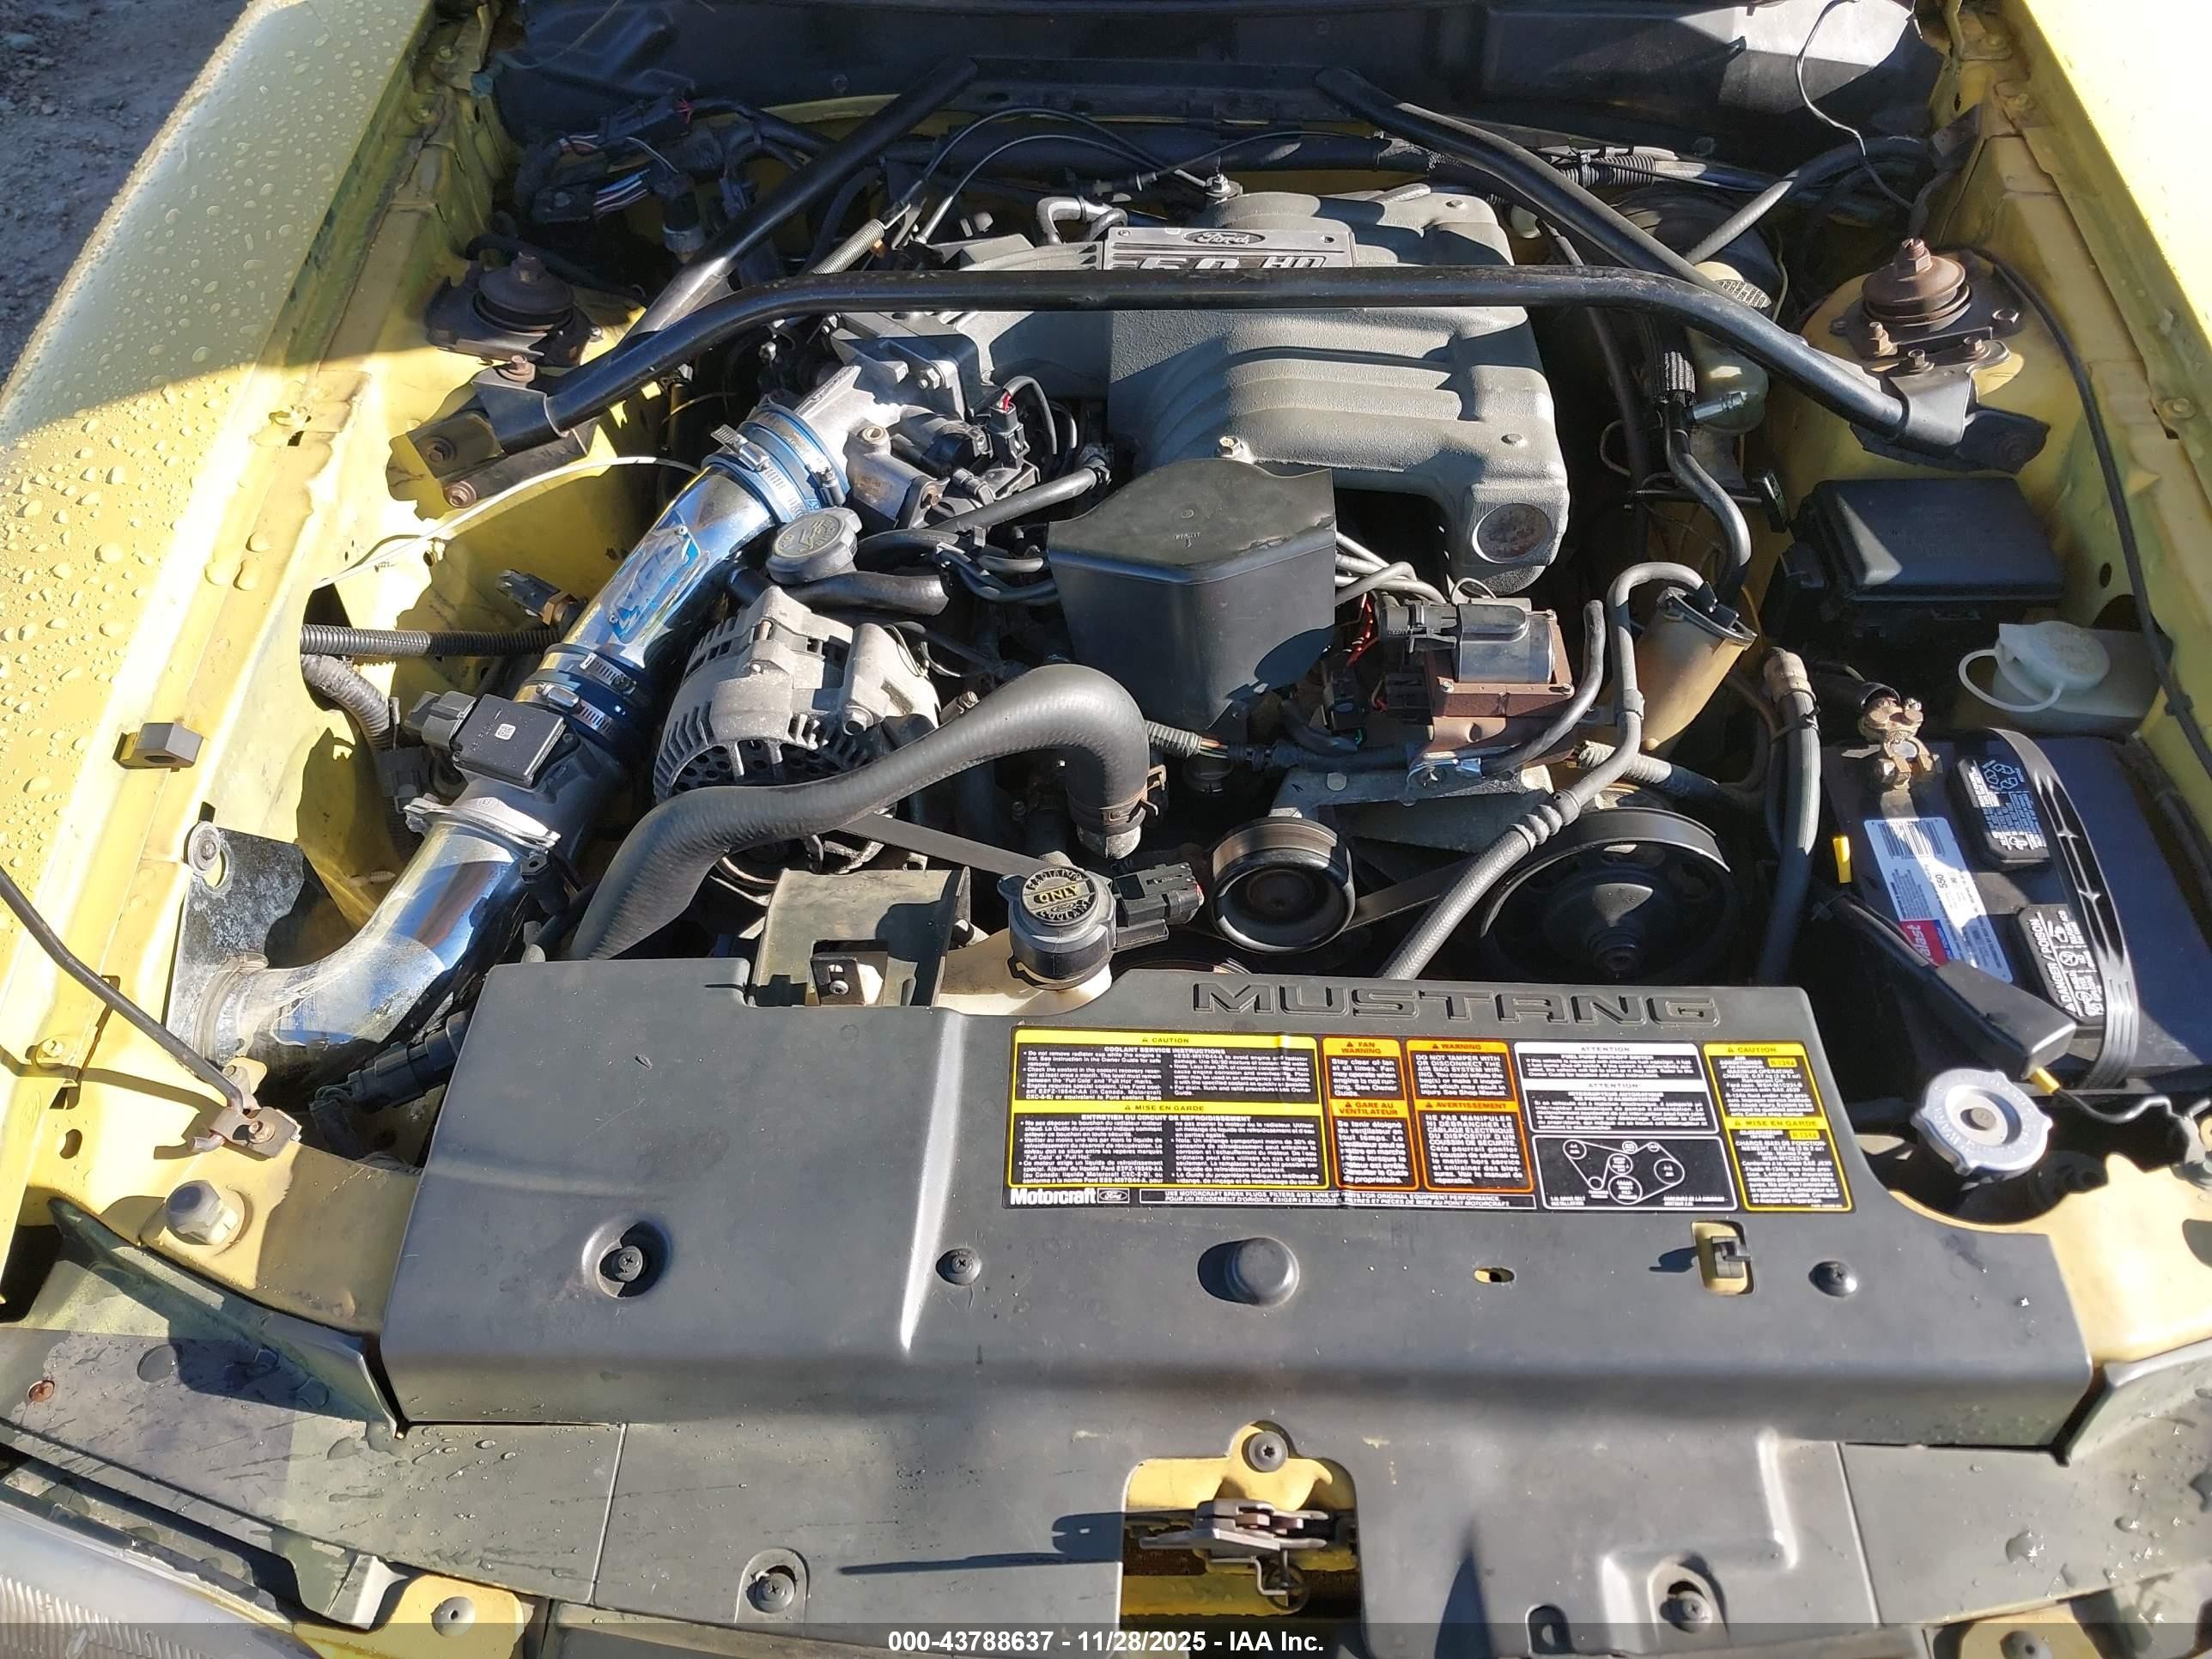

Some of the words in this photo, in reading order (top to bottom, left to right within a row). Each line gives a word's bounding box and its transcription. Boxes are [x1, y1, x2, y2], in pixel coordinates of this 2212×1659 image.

[1198, 232, 1249, 245] Ford
[1026, 869, 1082, 890] RADIATOR
[1935, 874, 1948, 889] 550
[1035, 885, 1079, 903] ONLY
[1036, 899, 1091, 921] COOLANT
[1907, 924, 1933, 957] alast
[2028, 918, 2052, 954] POISON
[2047, 962, 2072, 1002] DANGER
[1193, 982, 1722, 1028] MUSTANG
[1011, 1188, 1097, 1205] Motorcraft
